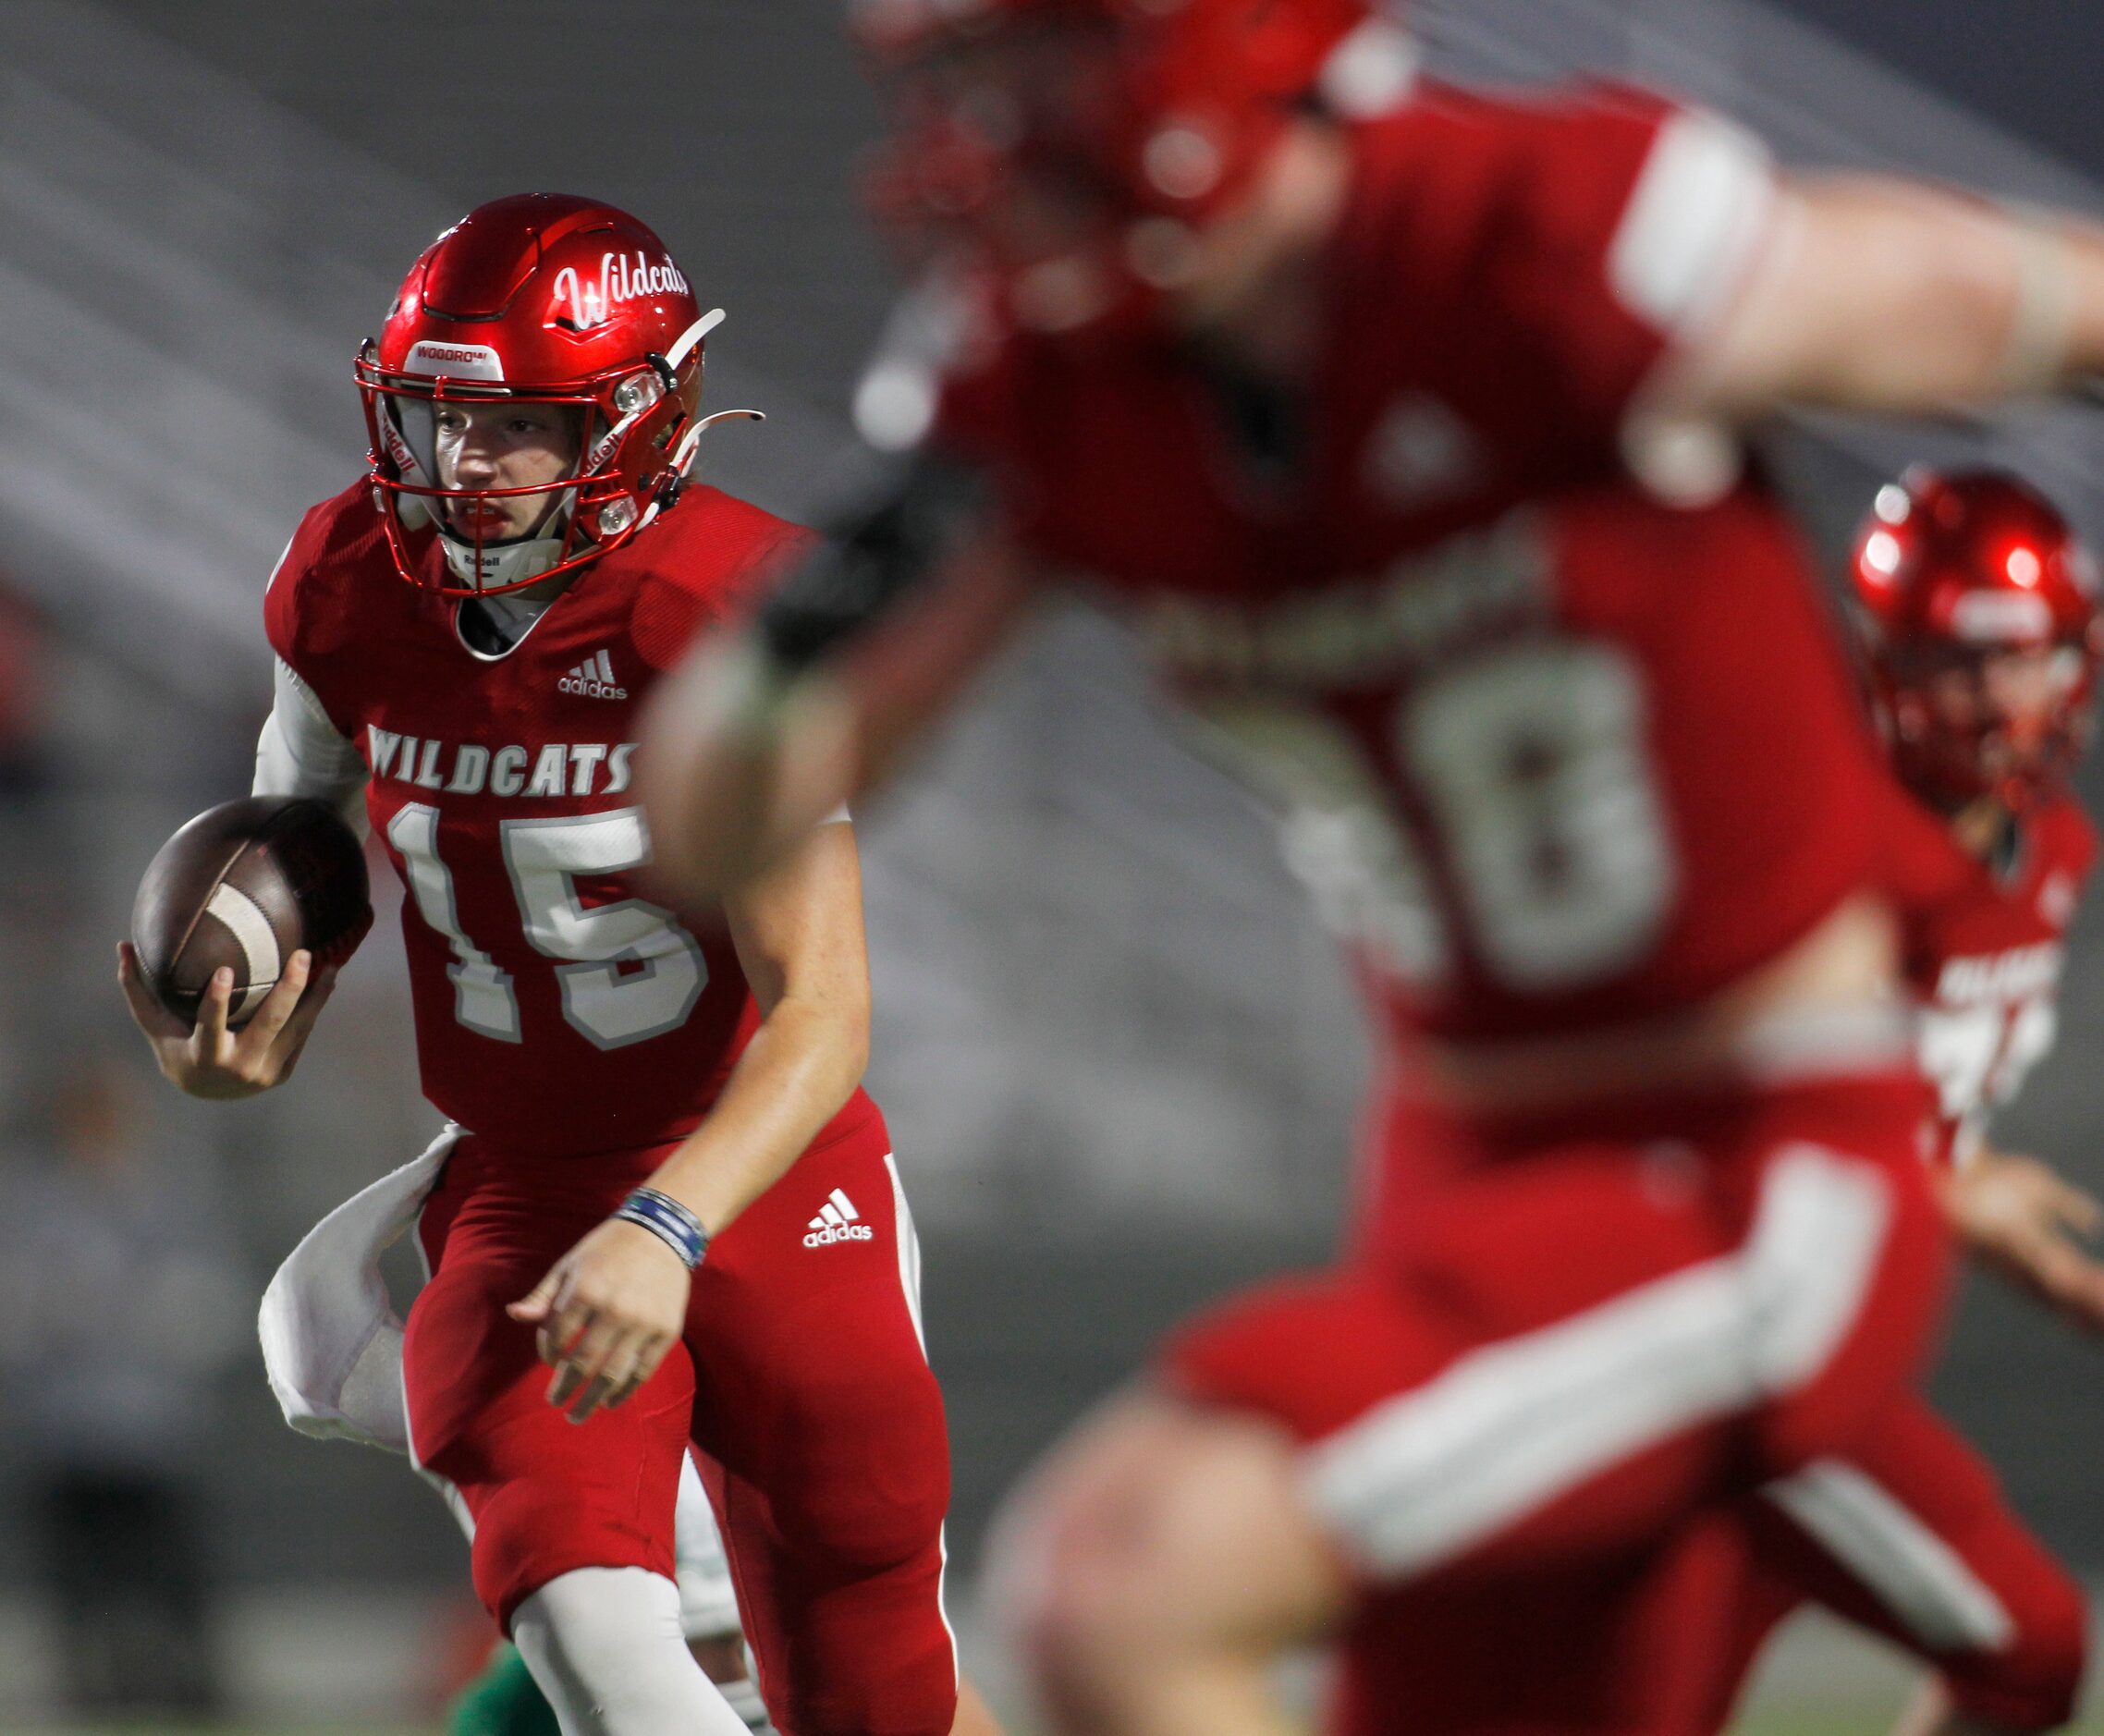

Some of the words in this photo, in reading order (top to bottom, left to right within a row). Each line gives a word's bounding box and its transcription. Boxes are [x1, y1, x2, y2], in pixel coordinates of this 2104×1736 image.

[554, 251, 689, 330] Wildcats
[585, 432, 622, 473] ddell
[464, 554, 500, 567] Ridell
[557, 677, 628, 700] adidas
[368, 724, 642, 797] WILDCATS
[387, 801, 709, 1051] 15
[802, 1220, 874, 1248] adidas
